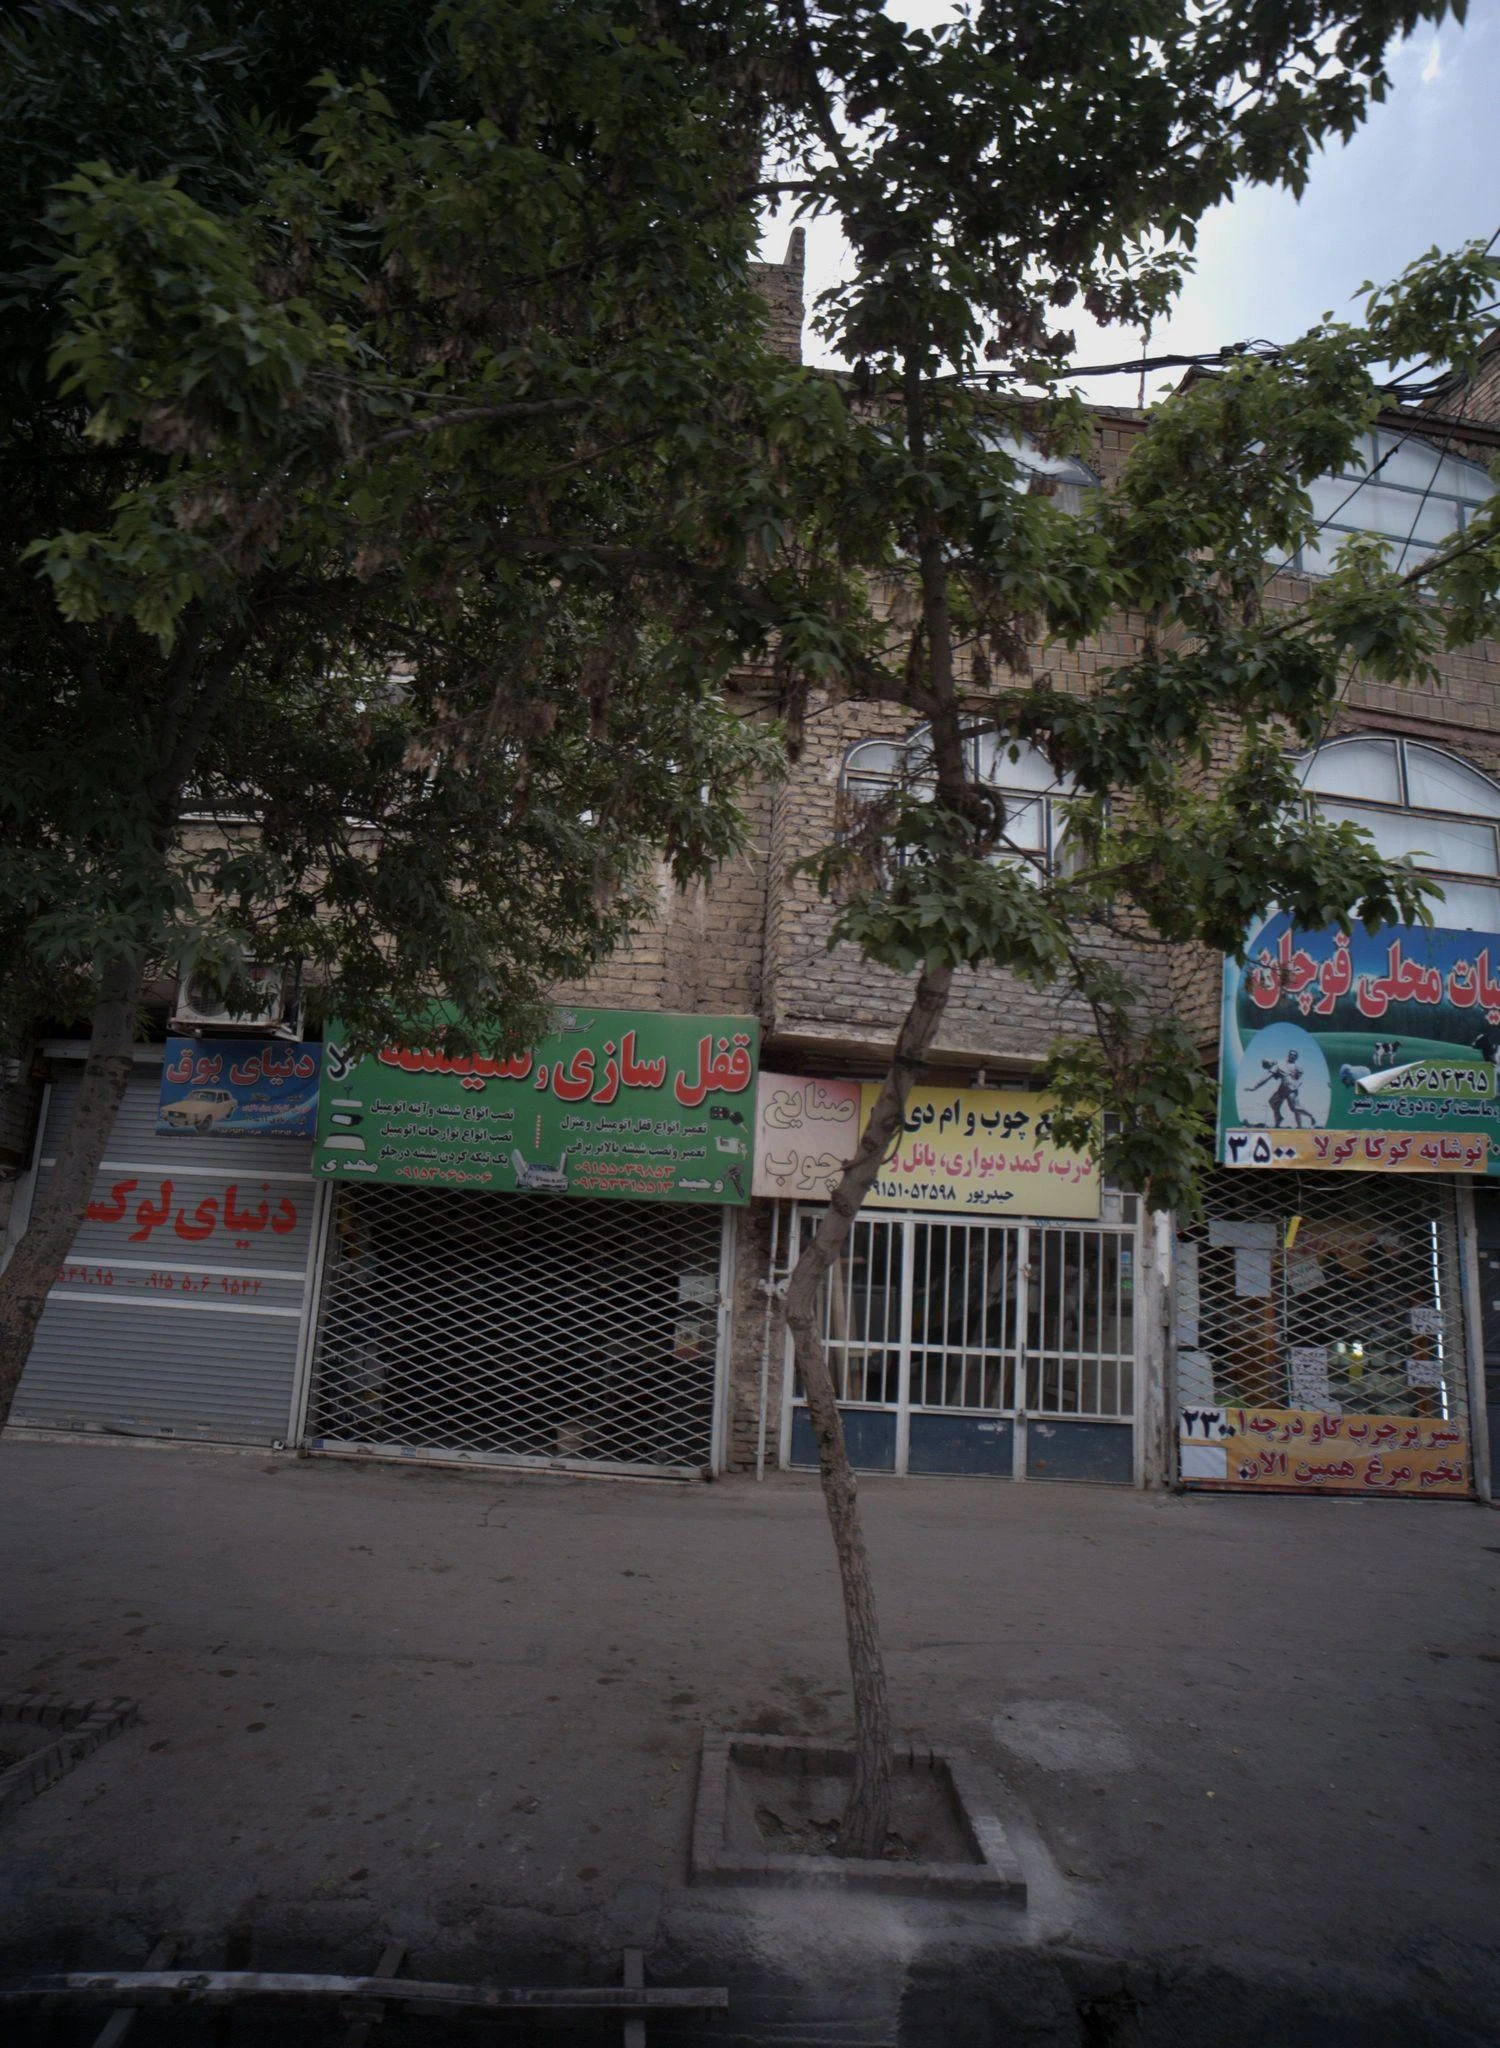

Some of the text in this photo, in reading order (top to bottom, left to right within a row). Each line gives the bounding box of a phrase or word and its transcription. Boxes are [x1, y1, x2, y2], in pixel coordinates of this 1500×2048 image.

[1249, 928, 1352, 1017] قوچان
[1357, 938, 1442, 1018] محلی
[166, 1048, 223, 1085] بوق
[229, 1047, 315, 1087] دنیای
[533, 1064, 549, 1090] و
[552, 1029, 667, 1104] سازی
[674, 1032, 752, 1107] قفل
[1388, 1067, 1488, 1092] ۵۸۶۵۴۳۹۵
[371, 1098, 406, 1115] اتومبیل
[436, 1104, 461, 1120] شیشه
[463, 1105, 489, 1121] انواع
[490, 1107, 515, 1122] نصب
[763, 1081, 857, 1130] صنایع
[903, 1102, 935, 1133] دی
[939, 1098, 961, 1135] ام
[381, 1120, 417, 1138] اتومبیل
[461, 1128, 487, 1143] انواع
[596, 1117, 631, 1134] اتومبیل
[633, 1118, 653, 1134] قفل
[654, 1120, 680, 1136] انواع
[682, 1121, 708, 1137] تعمیر
[964, 1111, 975, 1136] و
[981, 1109, 1029, 1140] چوب
[488, 1130, 513, 1145] نصب
[566, 1137, 593, 1154] برقی
[1228, 1134, 1296, 1164] ۳۵۰۰
[412, 1147, 438, 1162] شیشه
[440, 1149, 469, 1166] کردن
[492, 1152, 509, 1168] یک
[621, 1143, 647, 1159] شیشه
[680, 1147, 706, 1161] تعمیر
[889, 1150, 898, 1174] و
[903, 1143, 936, 1176] پانل
[1010, 1150, 1044, 1174] کمد
[1419, 1136, 1484, 1168] نوشابه
[764, 1149, 843, 1193] چوب
[678, 1174, 725, 1194] وحید
[871, 1180, 1015, 1204] حیدرپور ۹۱۵۱۰۵۲۵۹۸
[174, 1183, 297, 1249] دنیای
[1427, 1420, 1460, 1449] شیر
[1294, 1458, 1355, 1482] همین
[1364, 1454, 1412, 1488] مرغ
[1420, 1458, 1463, 1488] تخم
